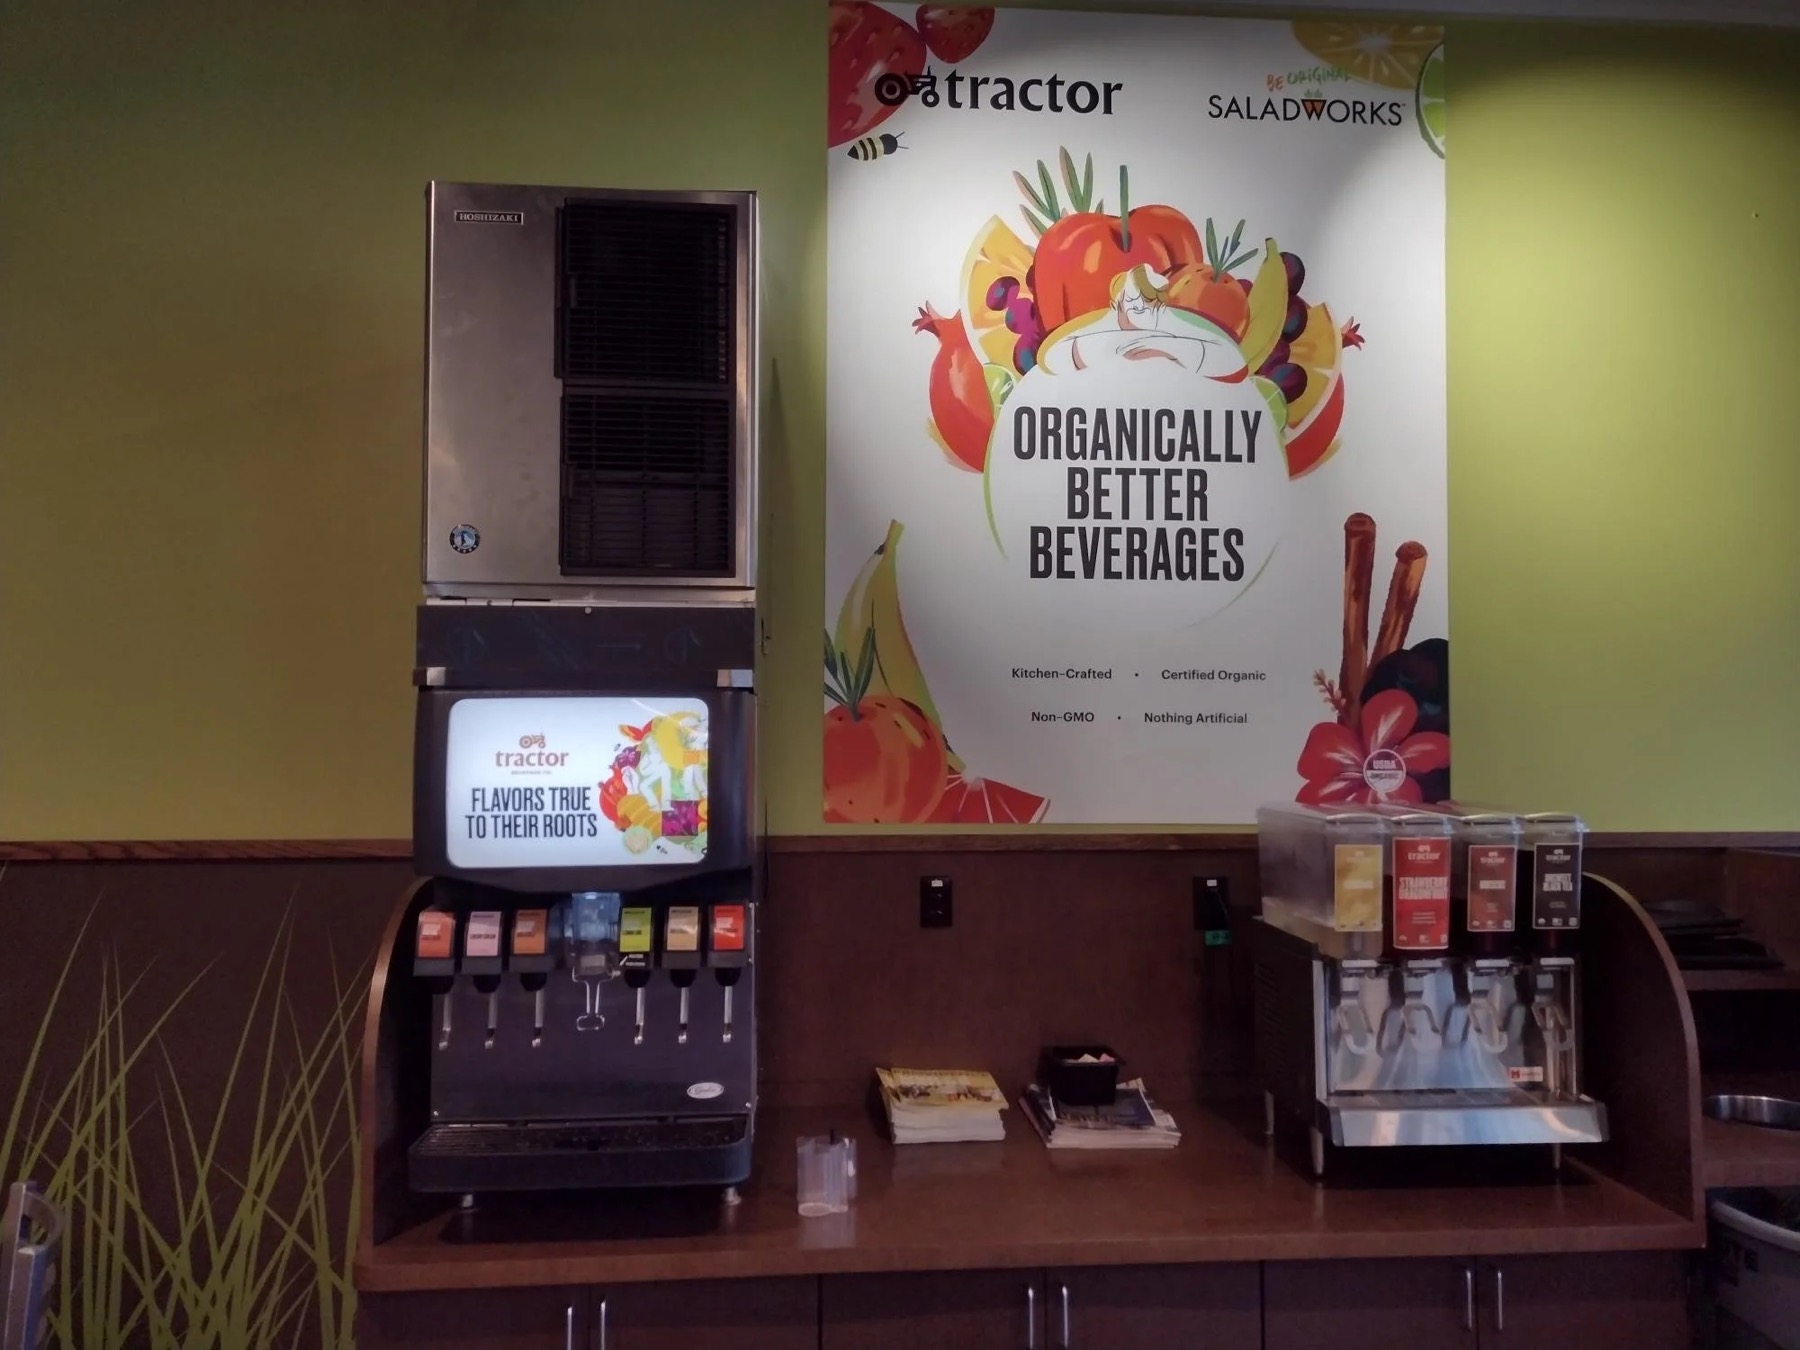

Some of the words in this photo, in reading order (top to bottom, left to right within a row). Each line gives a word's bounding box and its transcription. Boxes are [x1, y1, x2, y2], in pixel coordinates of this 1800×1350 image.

[1266, 74, 1284, 92] BE
[1287, 66, 1352, 85] ORIGINAL
[944, 70, 1123, 115] tractor
[1208, 94, 1402, 126] SALADWORKS
[459, 213, 518, 222] HOSHIZAKI
[1013, 406, 1262, 464] ORGANICALLY
[1067, 467, 1208, 521] BETTER
[1030, 526, 1245, 582] BEVERAGES
[1161, 668, 1214, 681] Certified
[1217, 669, 1266, 683] Organic
[1031, 711, 1095, 723] Non-GMO
[1144, 712, 1193, 725] Nothing
[1196, 711, 1248, 724] Artificial
[495, 751, 569, 767] tractor
[1373, 760, 1396, 769] USDA
[472, 787, 545, 812] FLAVORS
[548, 786, 591, 811] TRUE
[465, 815, 487, 839] TO
[490, 814, 539, 839] THEIR
[543, 813, 598, 838] ROOTS
